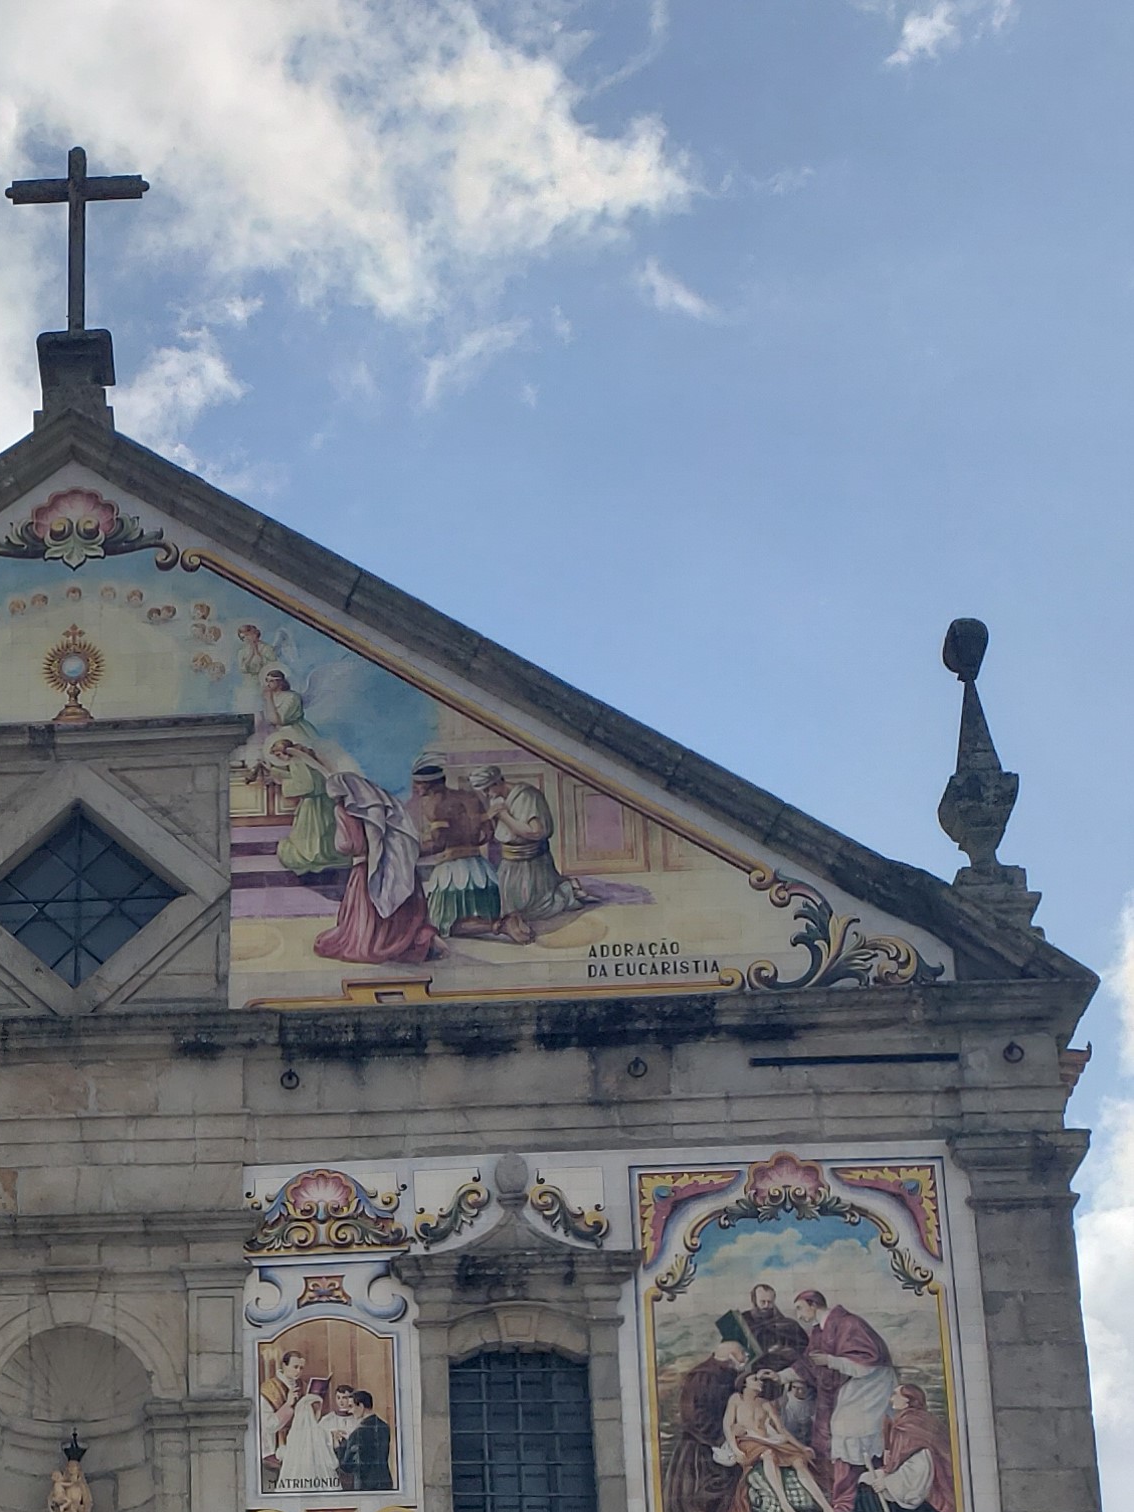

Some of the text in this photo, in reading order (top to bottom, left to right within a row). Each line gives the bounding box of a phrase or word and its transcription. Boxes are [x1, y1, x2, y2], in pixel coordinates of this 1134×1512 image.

[588, 937, 680, 958] ADORAÇÃO
[588, 959, 720, 978] DA EUCARISTIA
